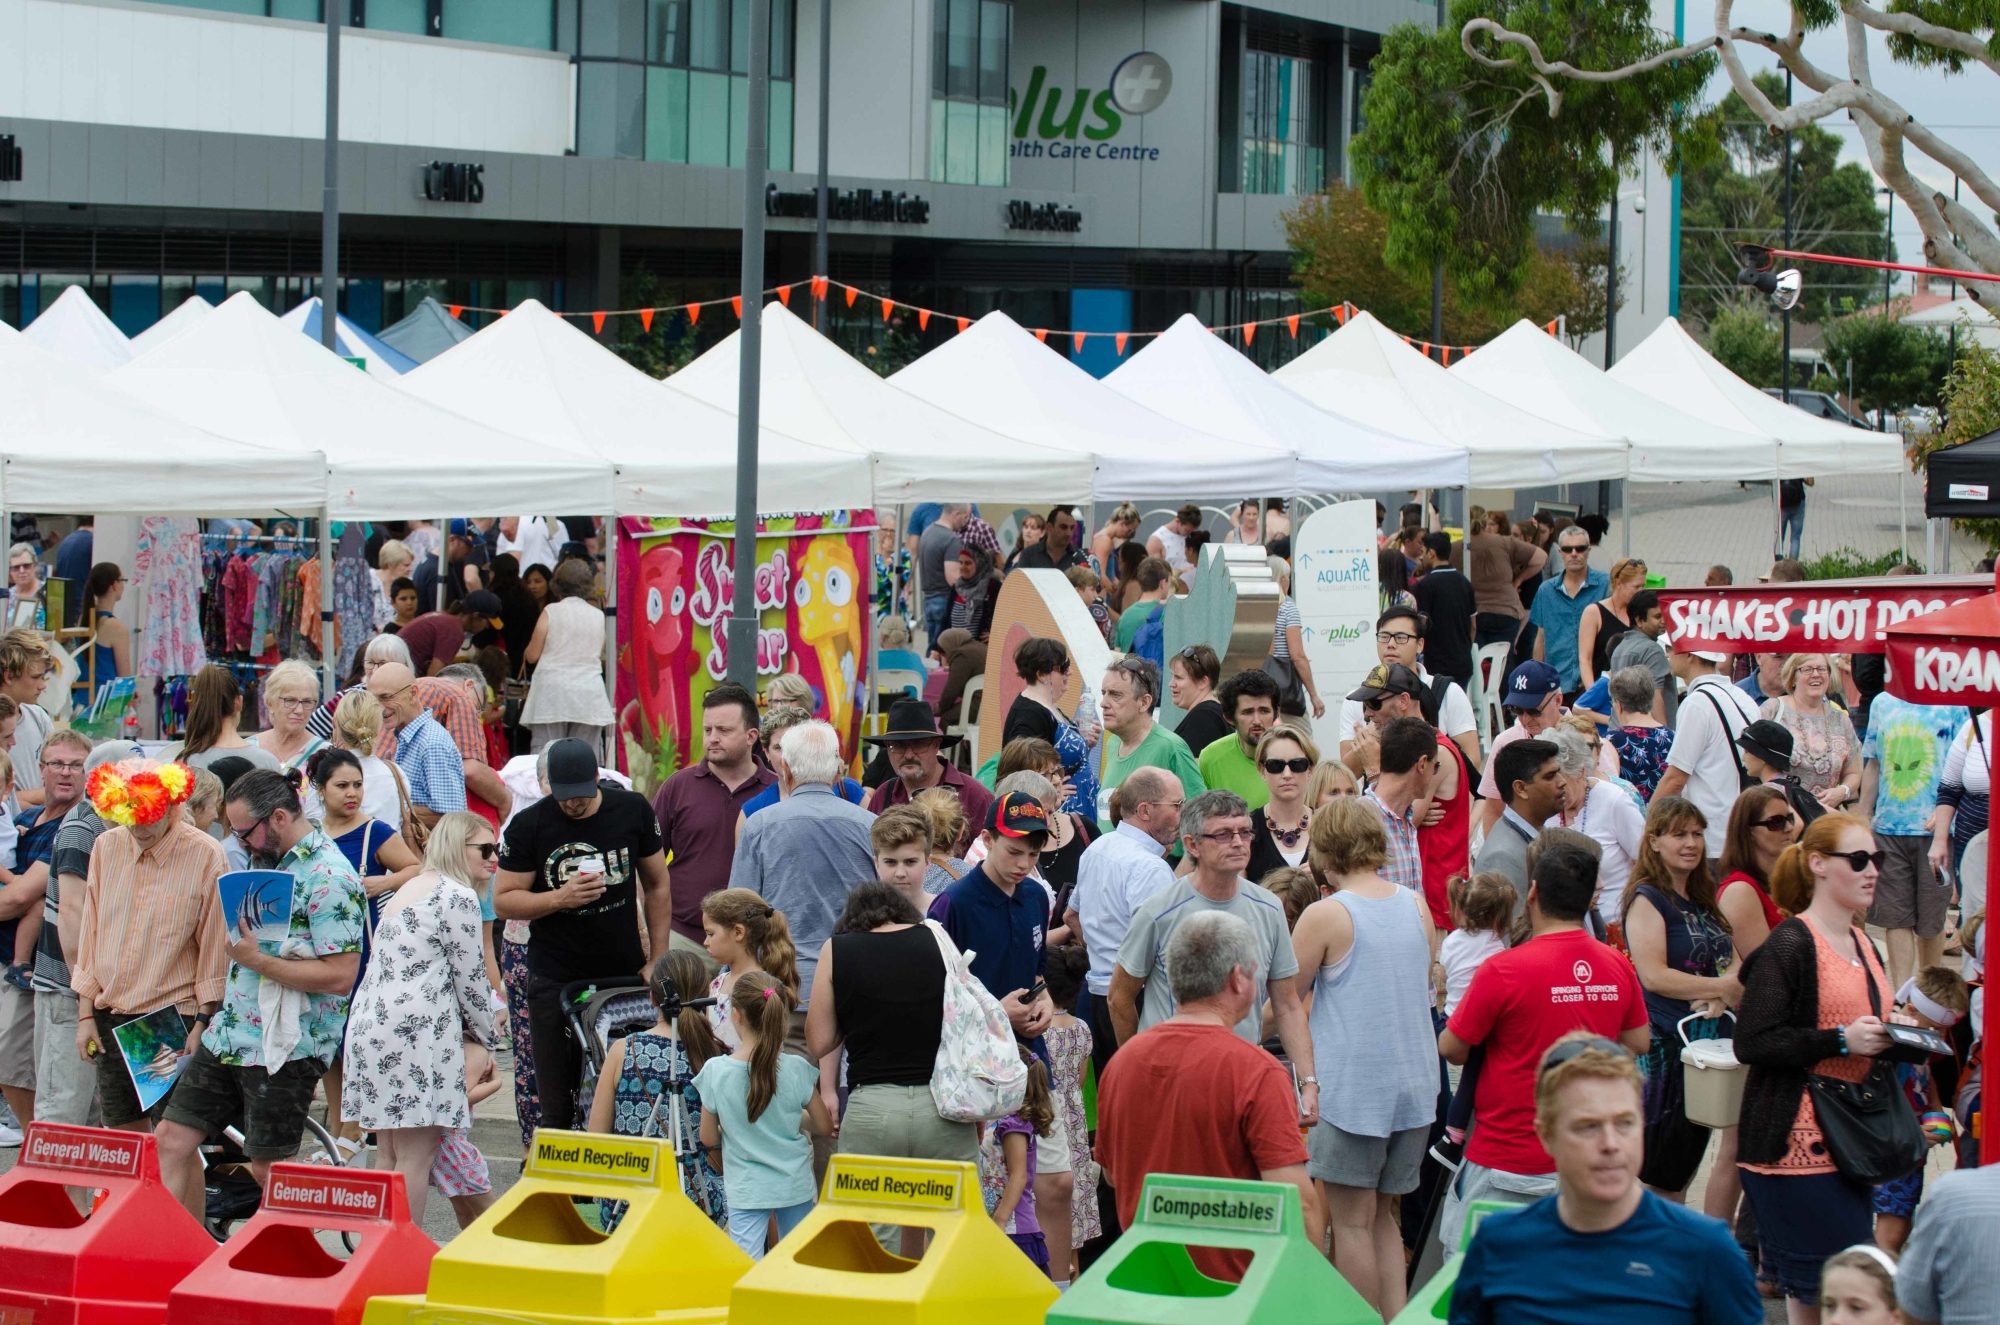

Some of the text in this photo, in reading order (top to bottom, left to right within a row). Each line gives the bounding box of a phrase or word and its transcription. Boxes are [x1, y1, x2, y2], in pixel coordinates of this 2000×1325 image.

[1011, 65, 1122, 141] lus
[1010, 141, 1160, 160] alth Care Centre
[1317, 569, 1371, 584] AQUATIC
[1352, 557, 1370, 572] SA
[1669, 597, 1793, 643] SHAKES
[1802, 598, 1871, 641] HOT
[1328, 624, 1360, 643] plus
[1551, 984, 1618, 995] BRINGING EVERYONE
[1552, 993, 1619, 1003] CLOSER TO GOD
[33, 1138, 131, 1166] General Waste
[538, 1144, 650, 1173] Mixed Recycling
[273, 1182, 377, 1209] General Waste
[836, 1173, 954, 1201] Mixed Recycling
[1152, 1195, 1275, 1221] Compostables
